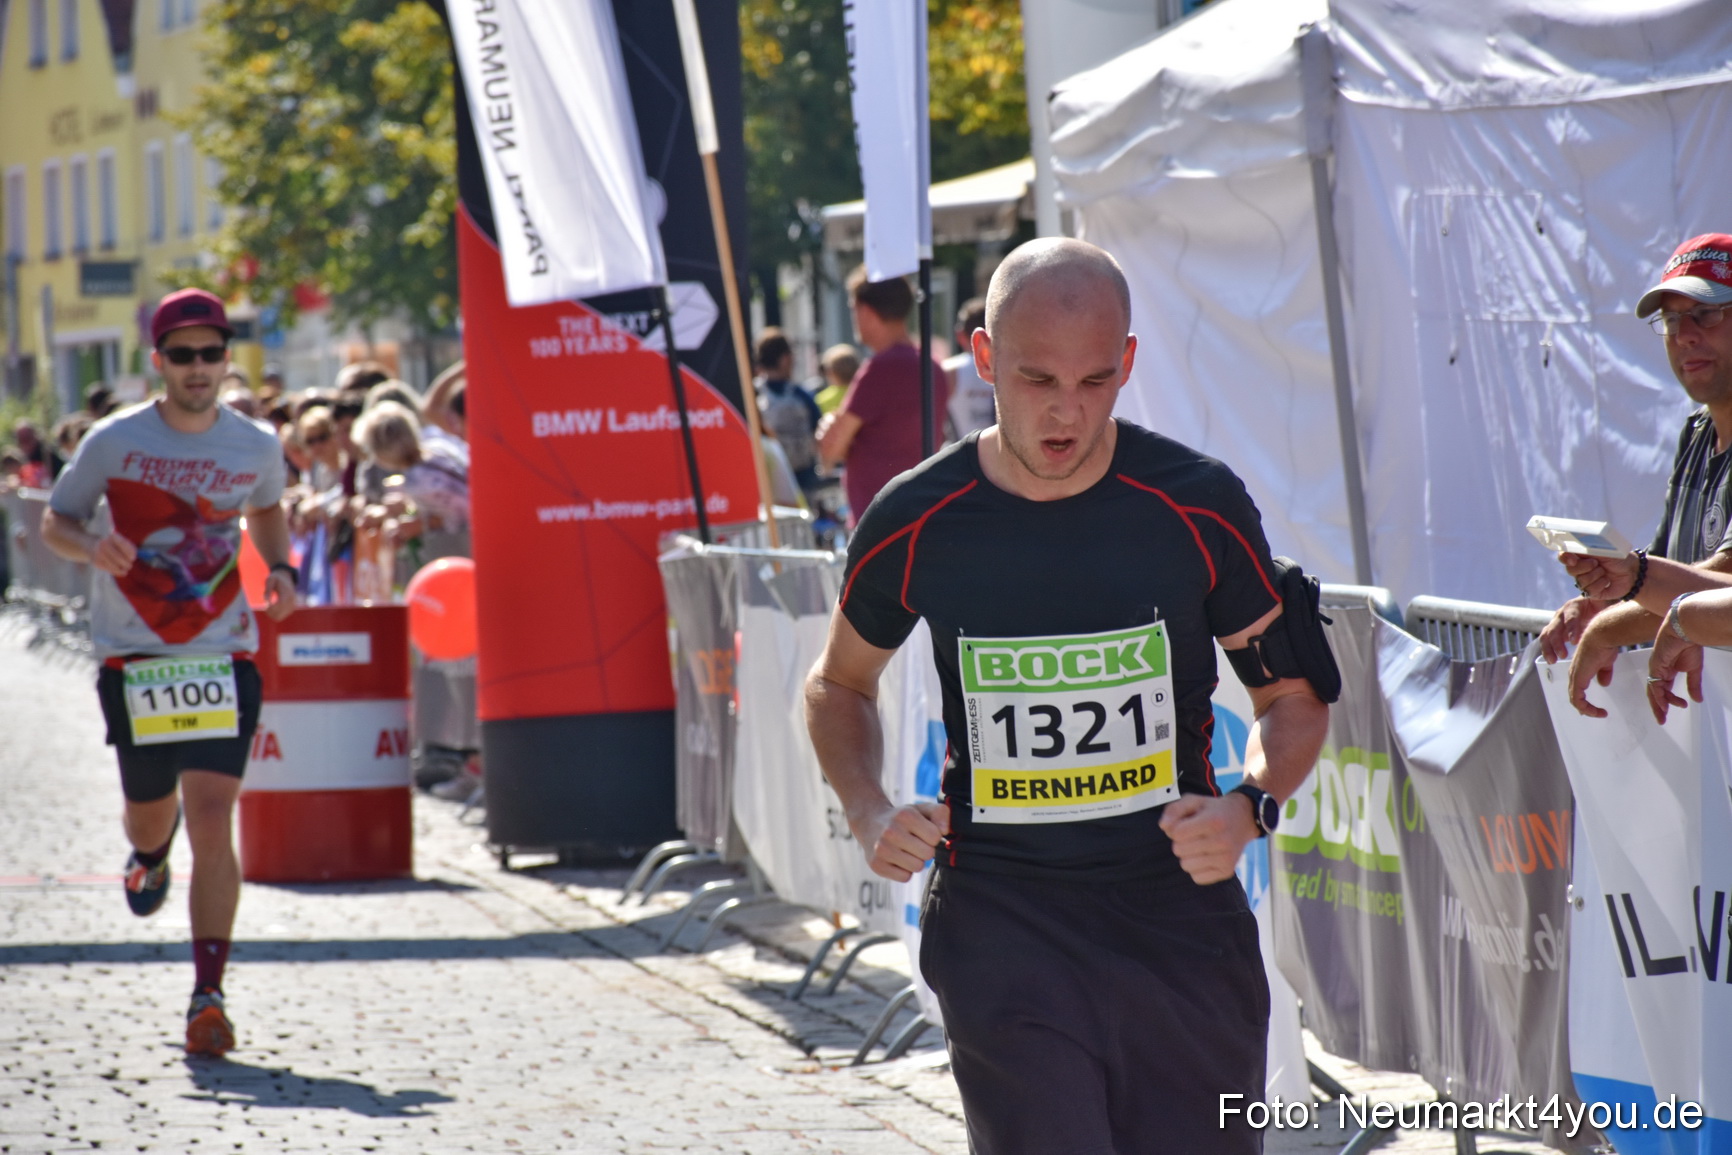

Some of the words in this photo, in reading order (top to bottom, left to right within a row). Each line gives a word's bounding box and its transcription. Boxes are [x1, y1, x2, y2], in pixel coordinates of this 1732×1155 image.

[558, 316, 595, 335] THE
[601, 311, 649, 333] NEXT
[529, 337, 562, 357] 100
[564, 334, 628, 354] YEARS
[532, 409, 602, 437] BMW
[607, 404, 725, 433] Laufsort
[978, 640, 1146, 681] BOCK
[141, 681, 224, 711] 1100
[1154, 693, 1165, 703] D
[171, 717, 198, 730] TIM
[991, 693, 1147, 759] 1321
[992, 763, 1156, 800] BERNHARD
[1275, 757, 1401, 857] BOCK
[1479, 809, 1569, 874] LOUN
